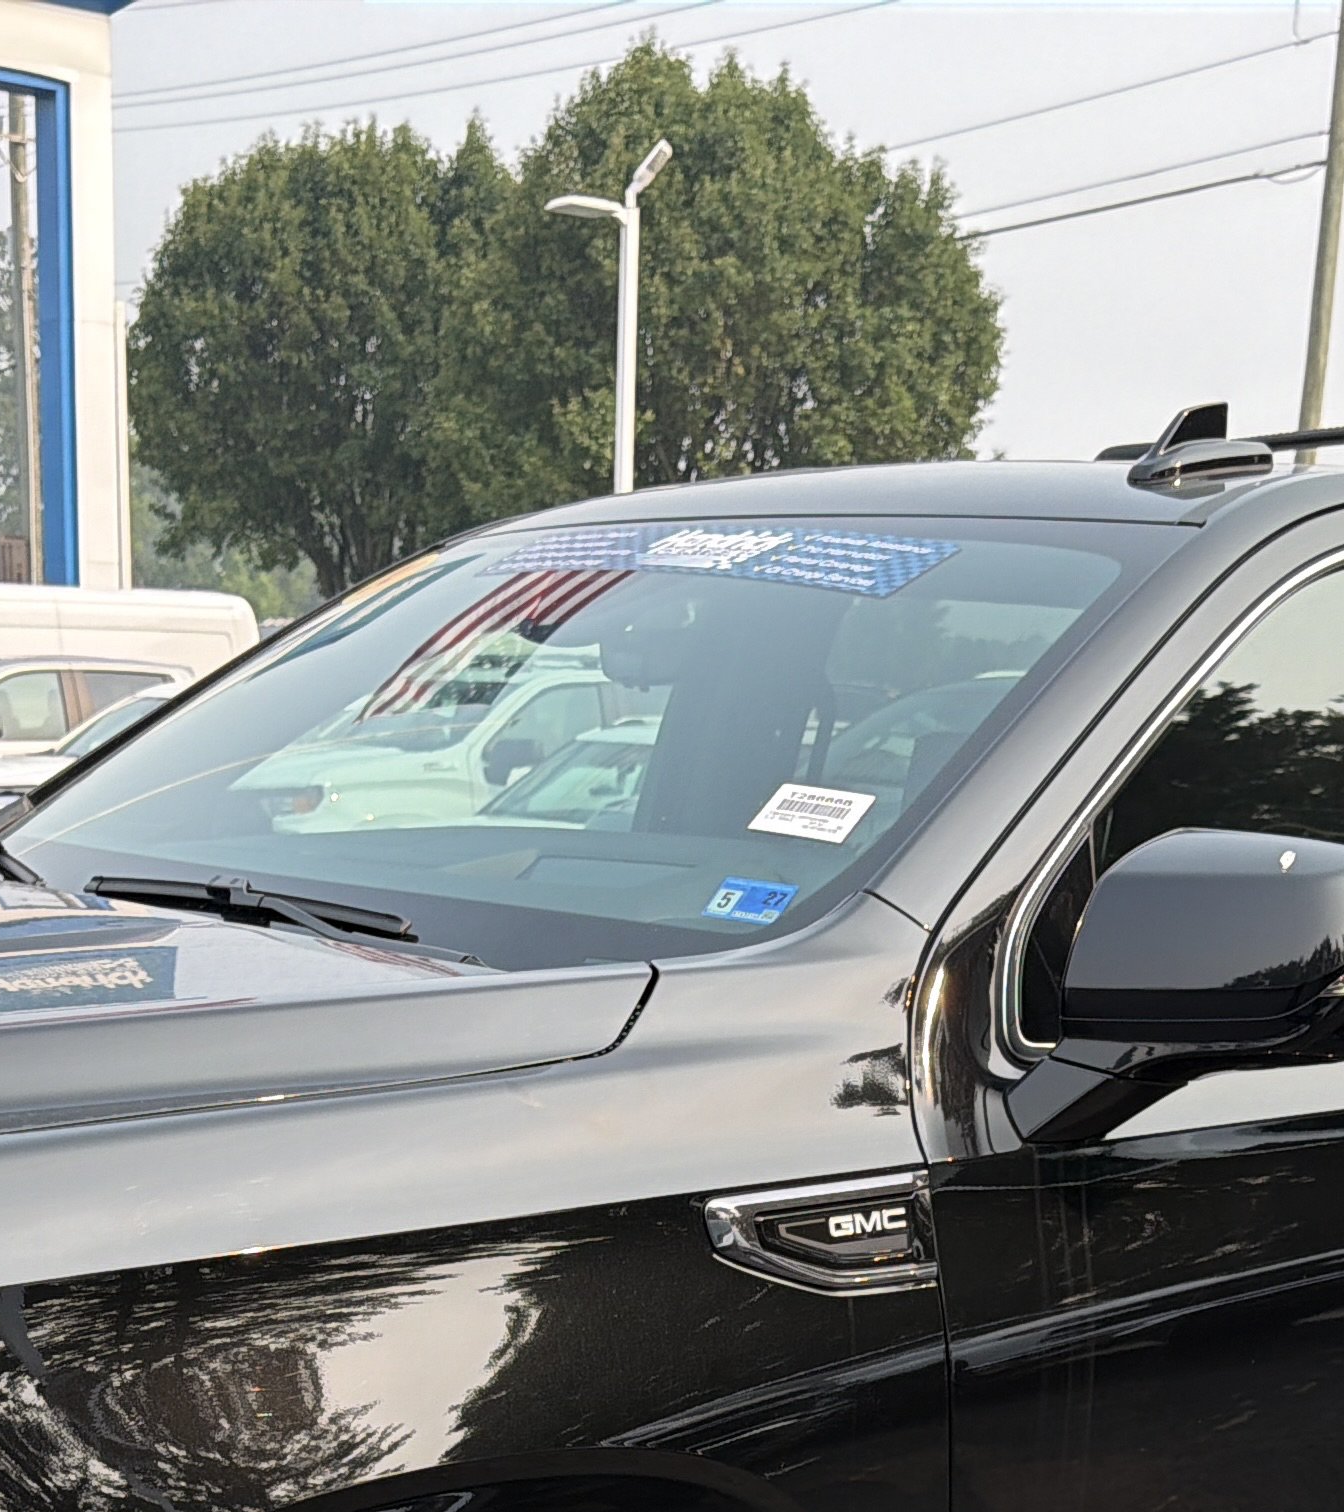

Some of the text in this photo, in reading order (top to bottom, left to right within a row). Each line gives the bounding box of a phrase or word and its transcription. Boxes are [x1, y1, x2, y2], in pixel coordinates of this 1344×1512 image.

[716, 891, 735, 909] 5
[762, 890, 789, 907] 27
[828, 1207, 907, 1238] GMC
